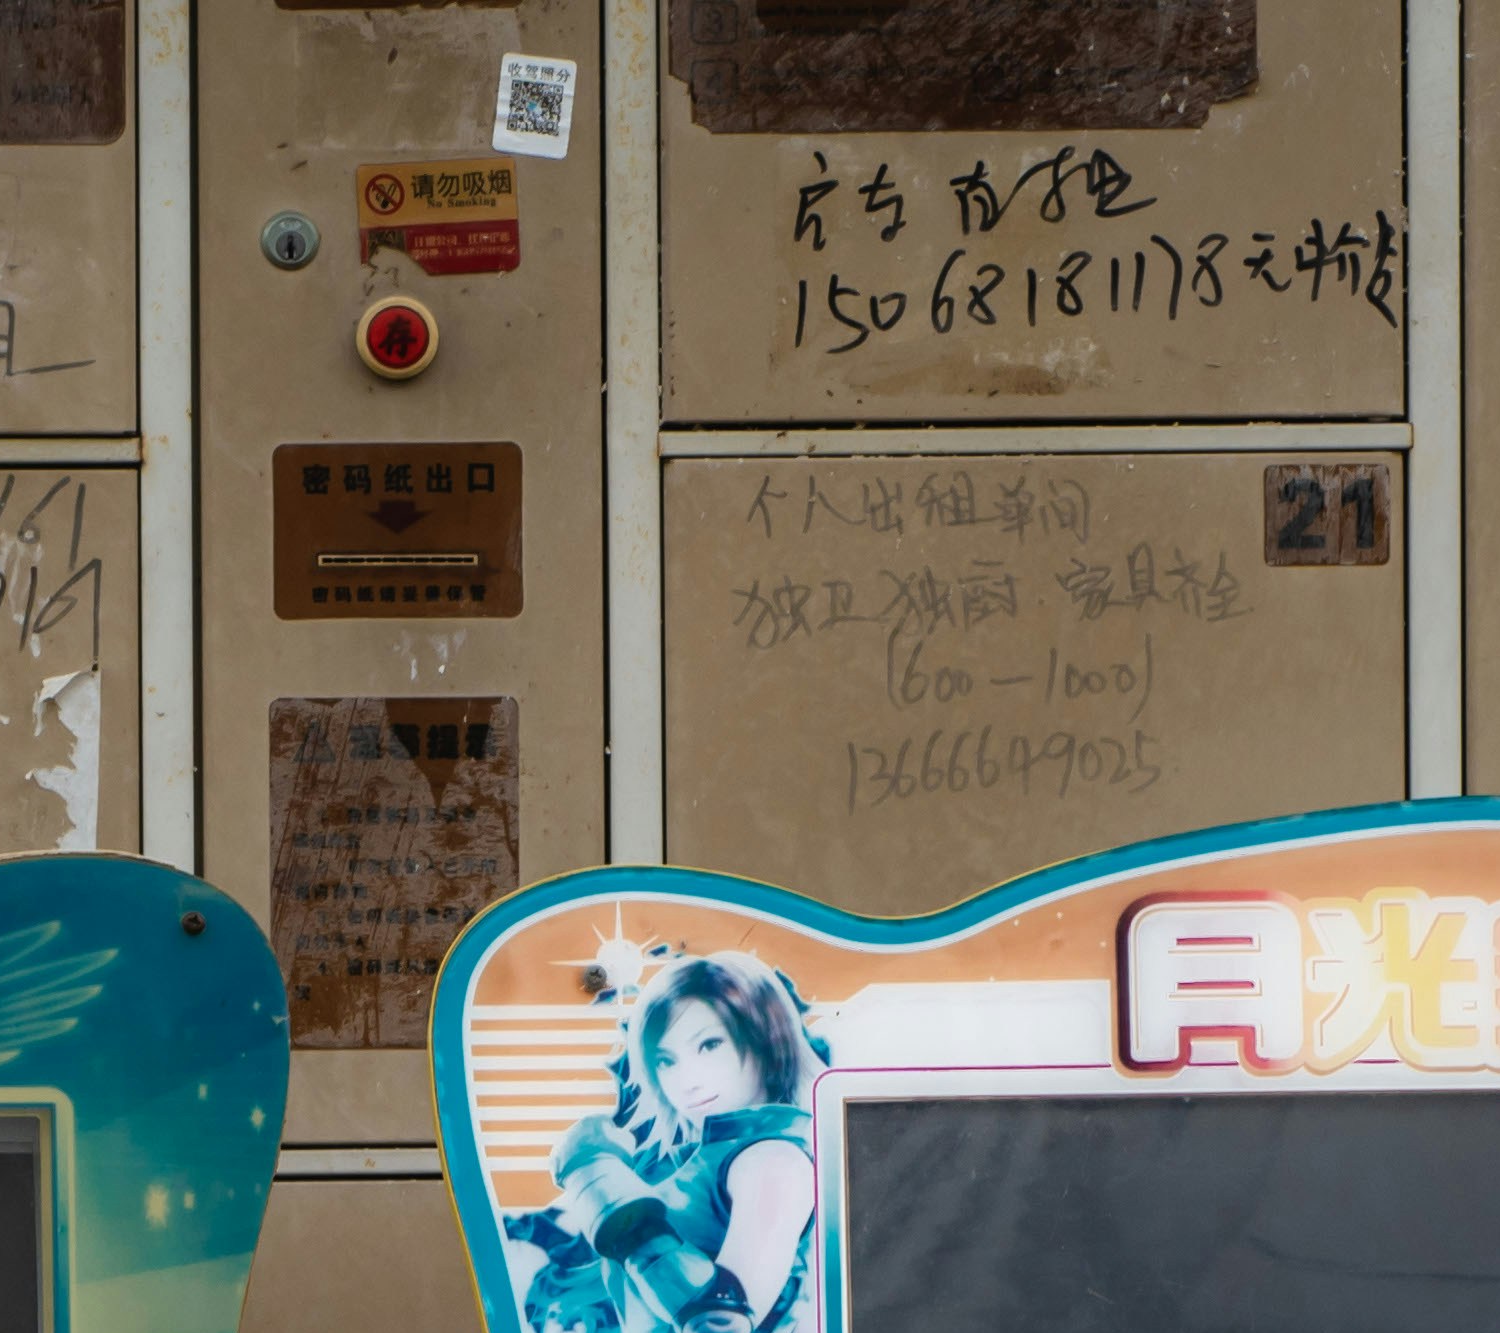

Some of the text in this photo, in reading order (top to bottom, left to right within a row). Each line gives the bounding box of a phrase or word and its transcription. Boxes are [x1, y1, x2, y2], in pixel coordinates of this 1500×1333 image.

[411, 169, 512, 198] 请勿吸烟
[447, 196, 497, 208] Smoking
[303, 463, 495, 495] 密码纸出口
[747, 473, 1090, 542] 个人出租单间
[1276, 480, 1377, 552] 21
